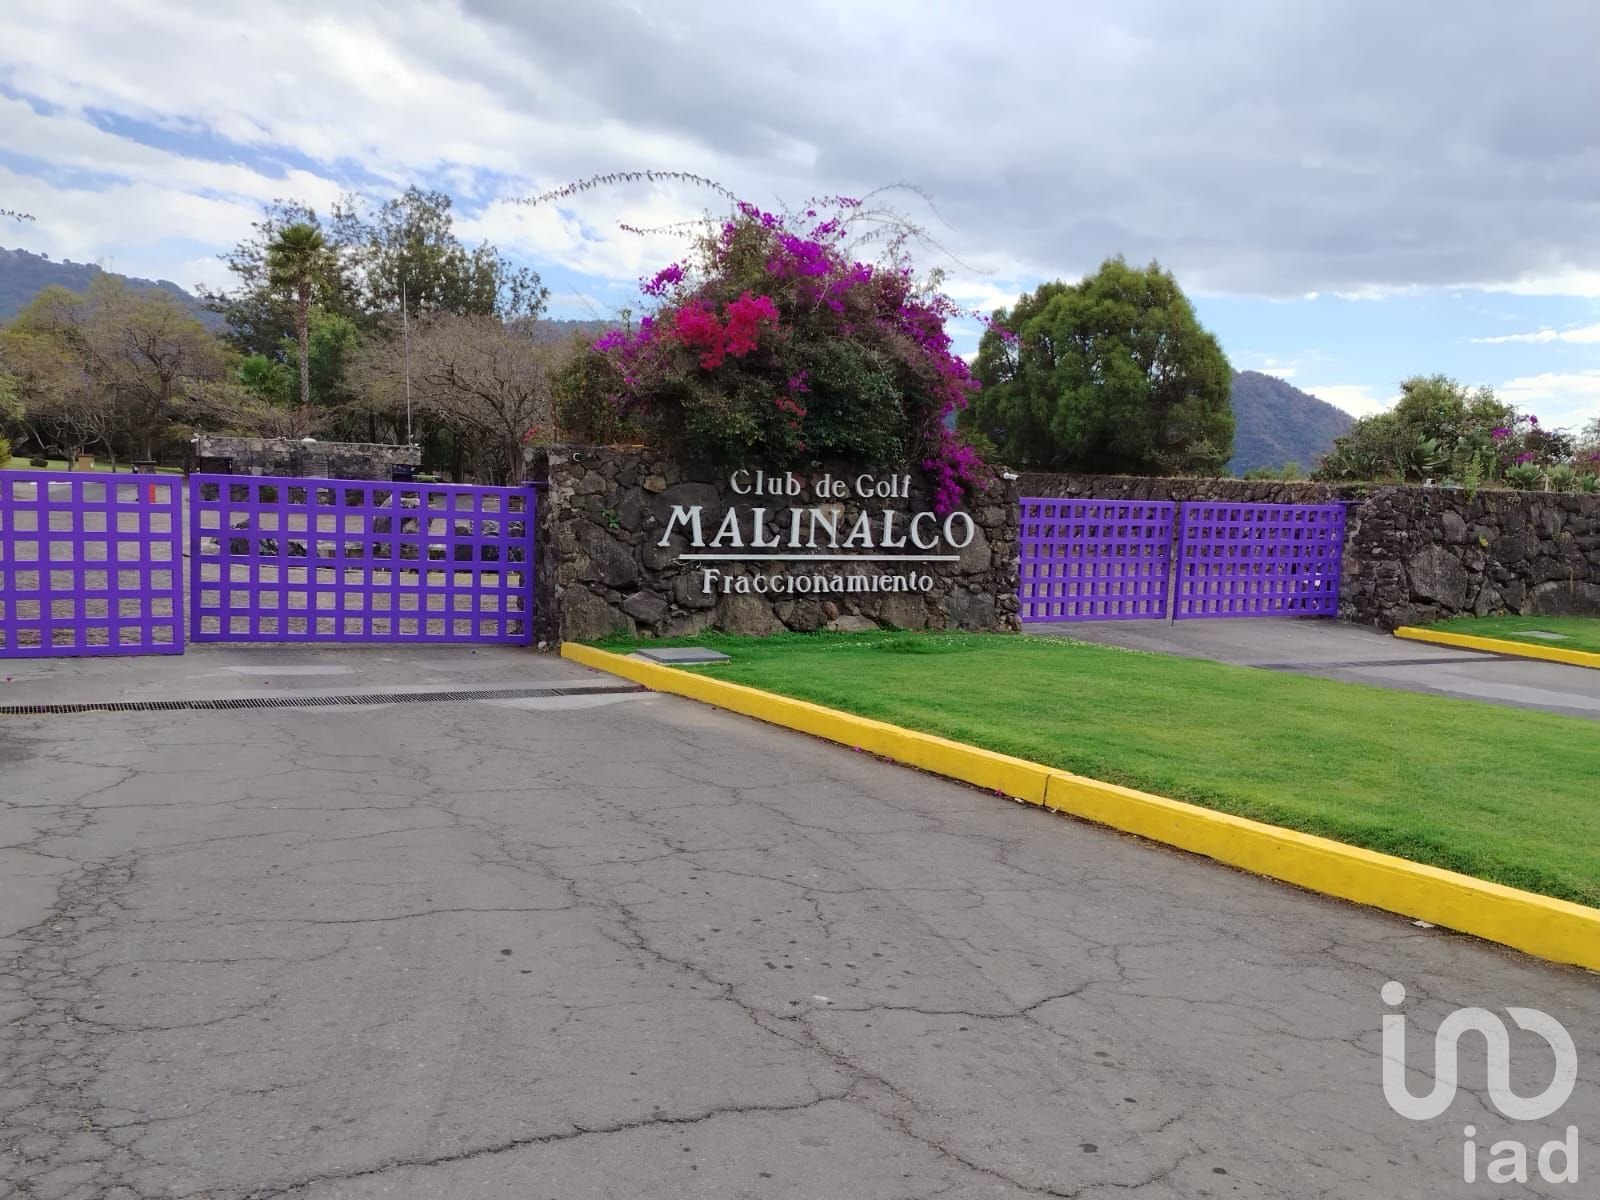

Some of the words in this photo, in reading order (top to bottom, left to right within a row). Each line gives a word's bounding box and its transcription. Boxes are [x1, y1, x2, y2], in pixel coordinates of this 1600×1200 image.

[730, 469, 801, 496] Club
[815, 473, 846, 498] de
[855, 473, 912, 498] Golf
[657, 505, 976, 549] MALINALCO
[701, 568, 933, 594] Fraccionamiento
